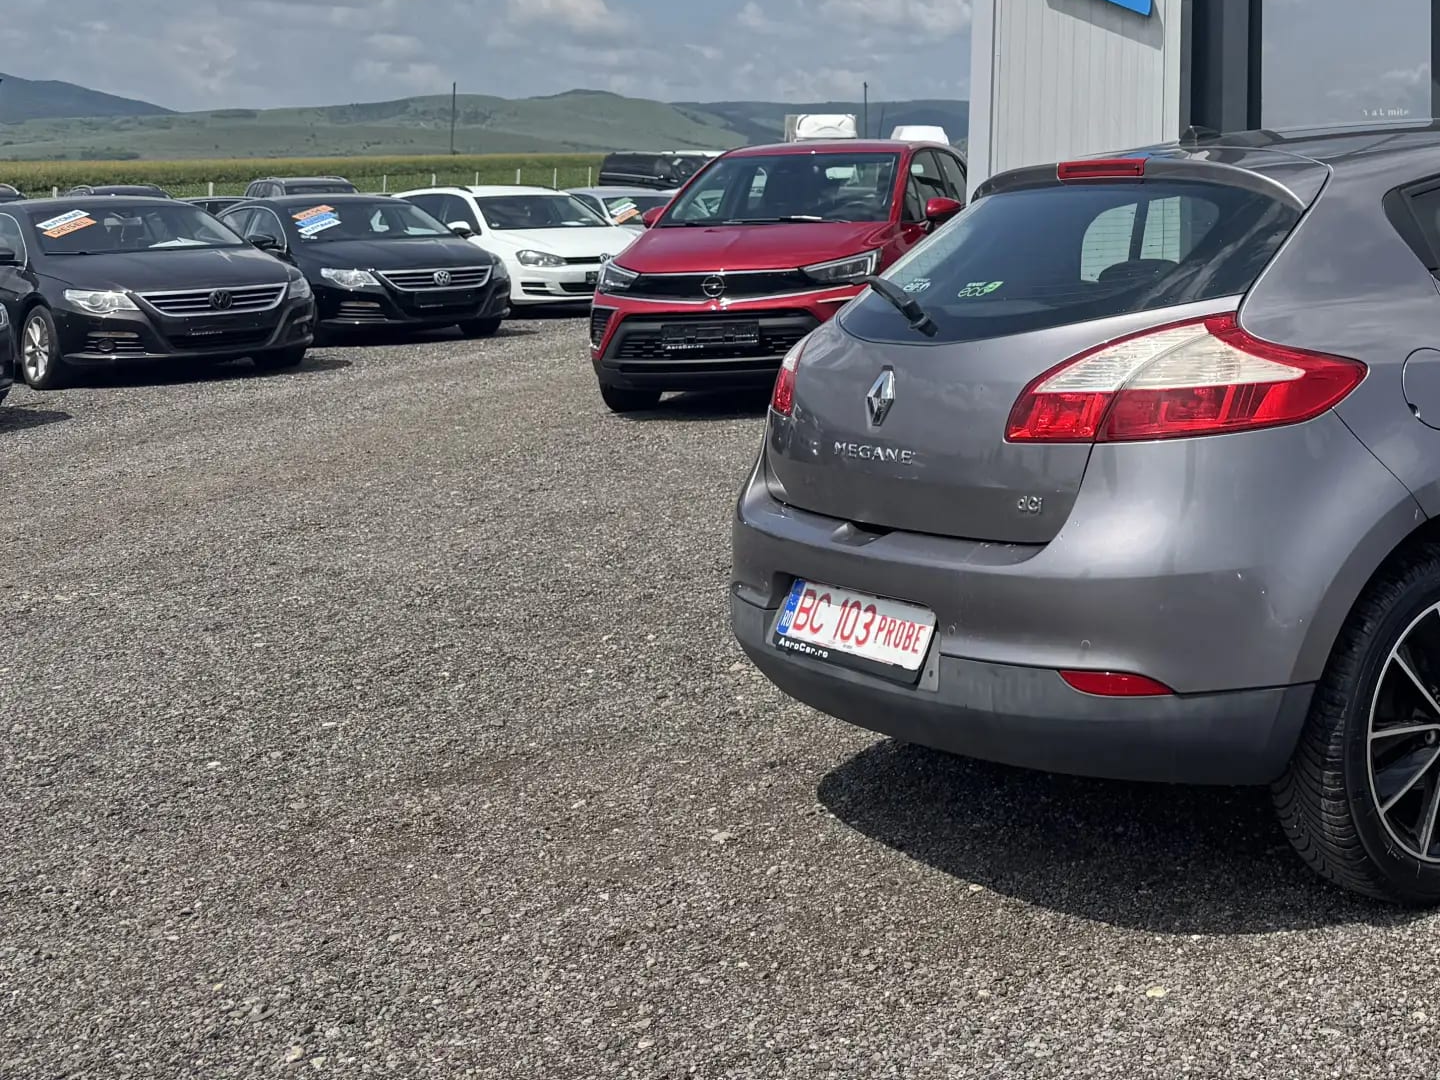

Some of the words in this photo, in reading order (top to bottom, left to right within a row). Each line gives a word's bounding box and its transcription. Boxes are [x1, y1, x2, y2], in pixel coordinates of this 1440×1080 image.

[834, 441, 913, 465] MEGANE
[792, 588, 832, 634] BC
[833, 597, 877, 647] 103
[873, 614, 927, 654] PROBE
[778, 636, 829, 659] AeroCar.ro
